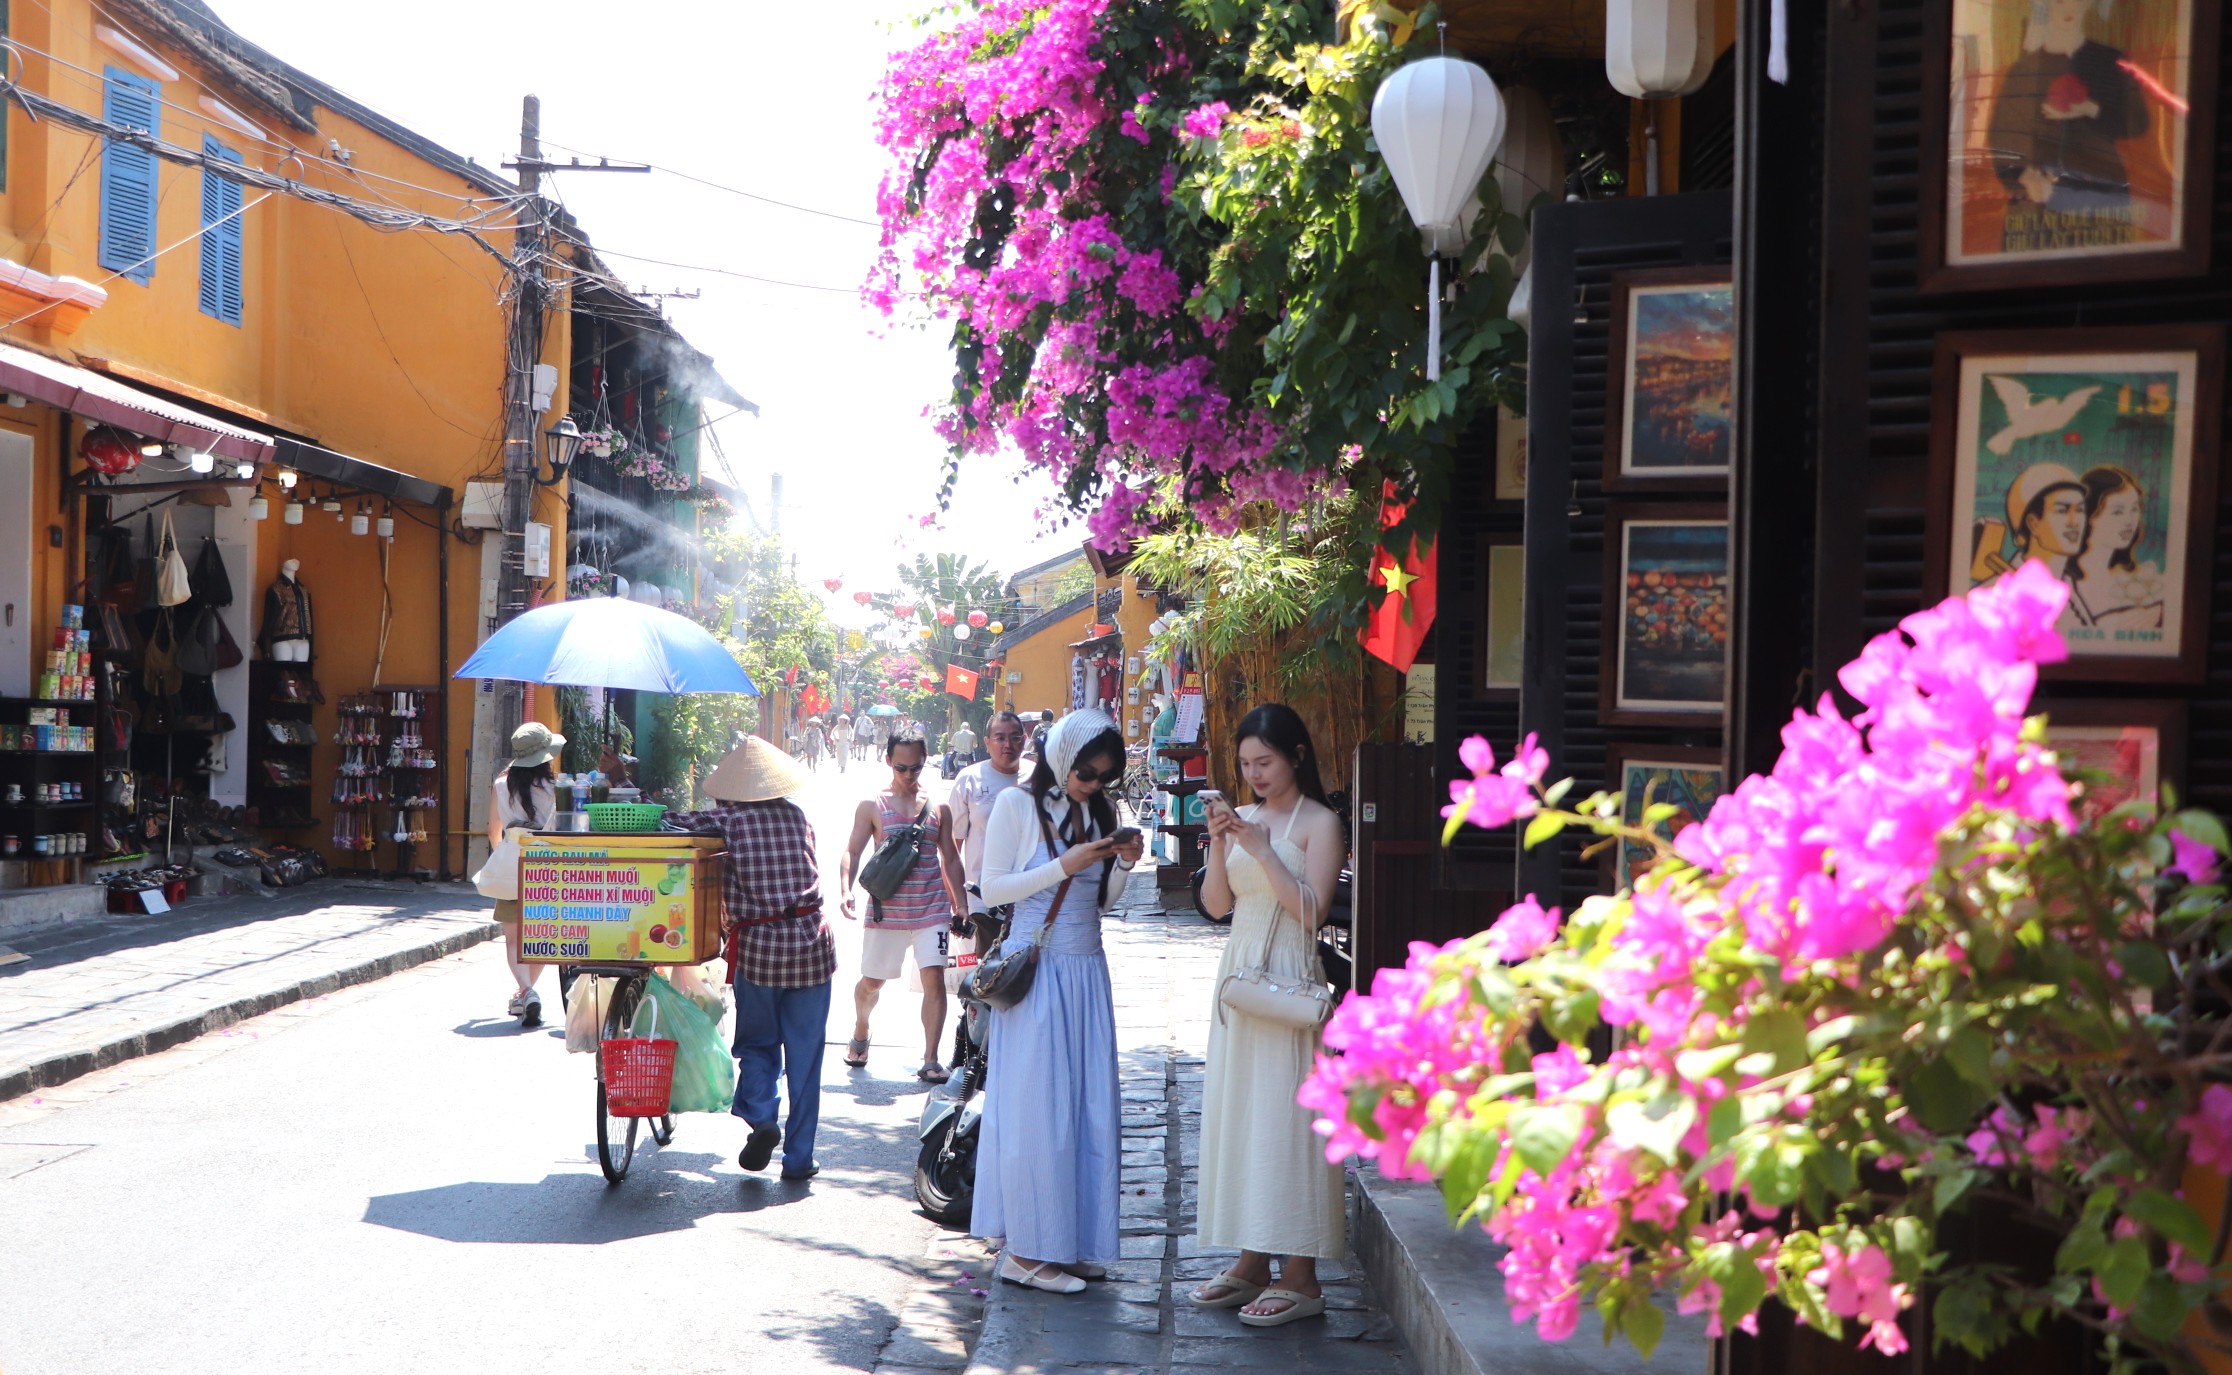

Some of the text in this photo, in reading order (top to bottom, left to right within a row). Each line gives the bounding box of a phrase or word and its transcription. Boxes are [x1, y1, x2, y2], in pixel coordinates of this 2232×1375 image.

[2118, 383, 2170, 415] 1.5
[525, 866, 639, 885] NƯỚC CHANH MUỐI
[524, 885, 559, 902] NƯỚC
[561, 887, 604, 903] CHANH
[622, 886, 655, 906] MUỘI
[524, 904, 558, 920] NƯỚC
[561, 906, 603, 921] CHANH
[523, 922, 589, 939] NƯỚC CAM
[523, 940, 590, 957] NƯỚC SUỐI
